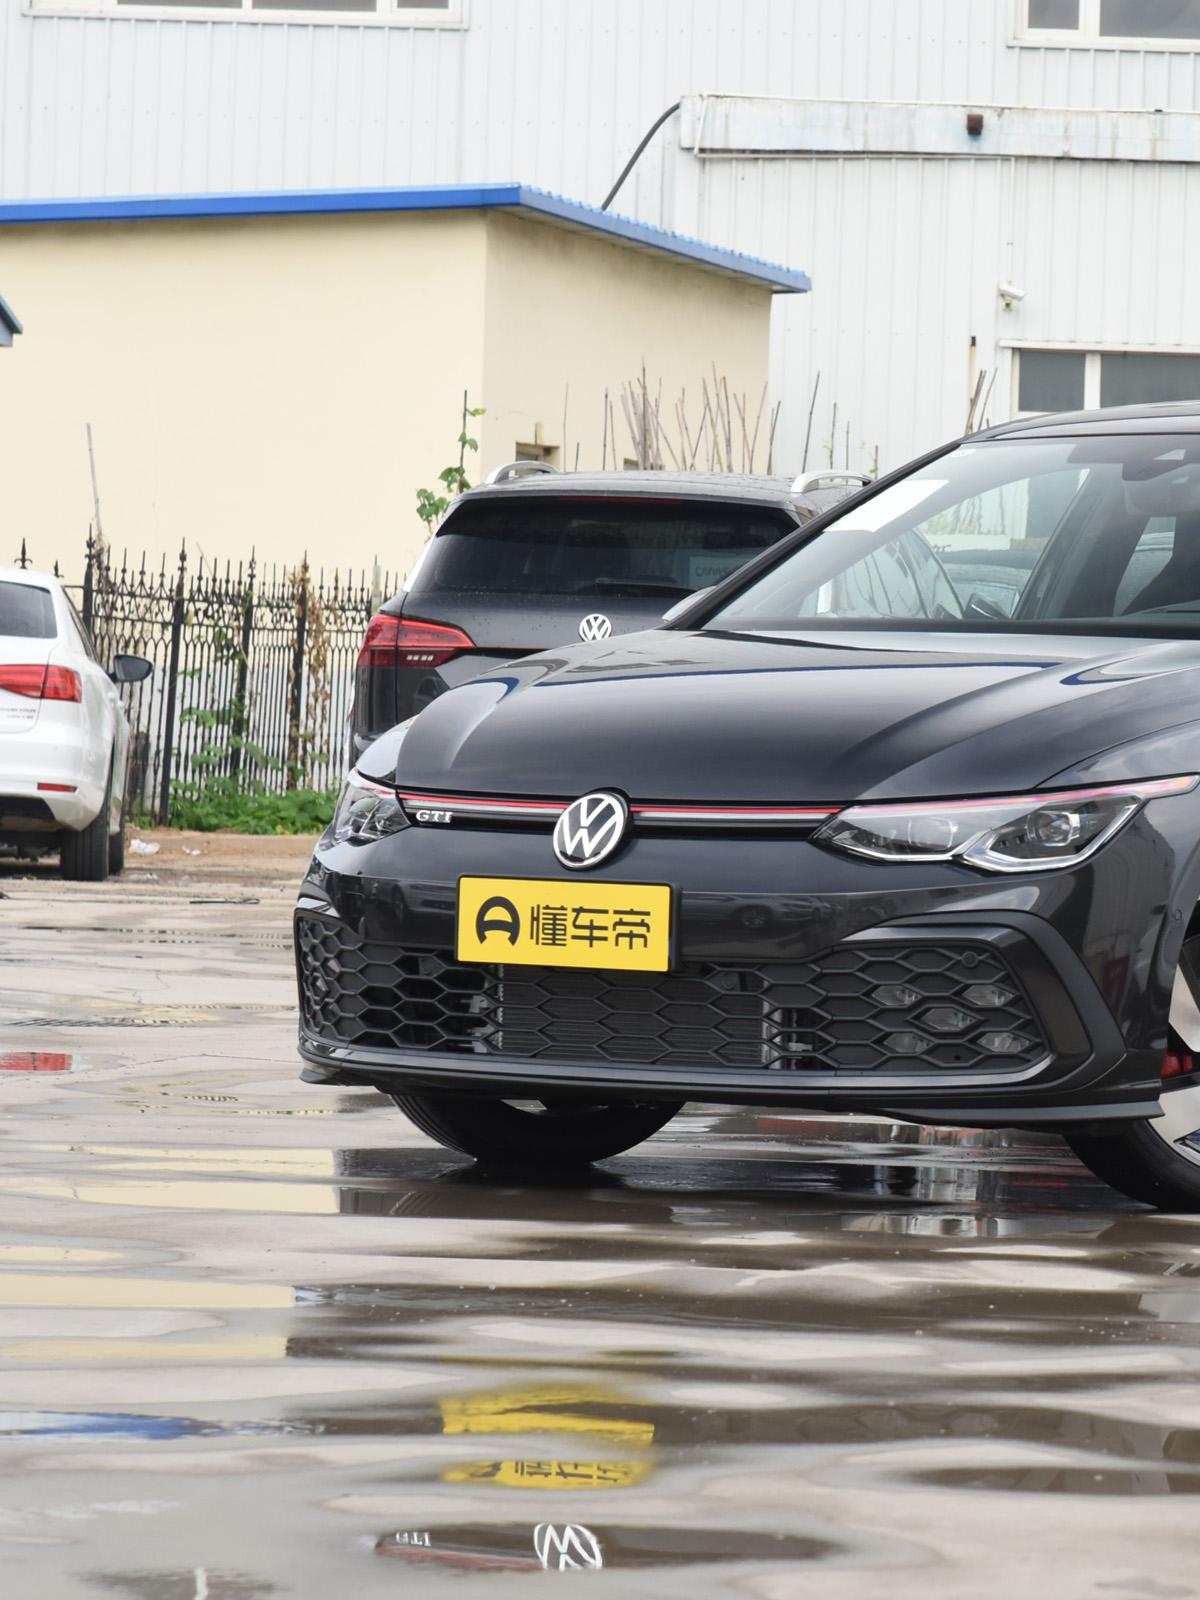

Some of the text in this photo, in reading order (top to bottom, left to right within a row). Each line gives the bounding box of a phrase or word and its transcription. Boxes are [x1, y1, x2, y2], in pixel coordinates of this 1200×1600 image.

[416, 810, 453, 823] GTI
[530, 904, 651, 949] 懂车帝
